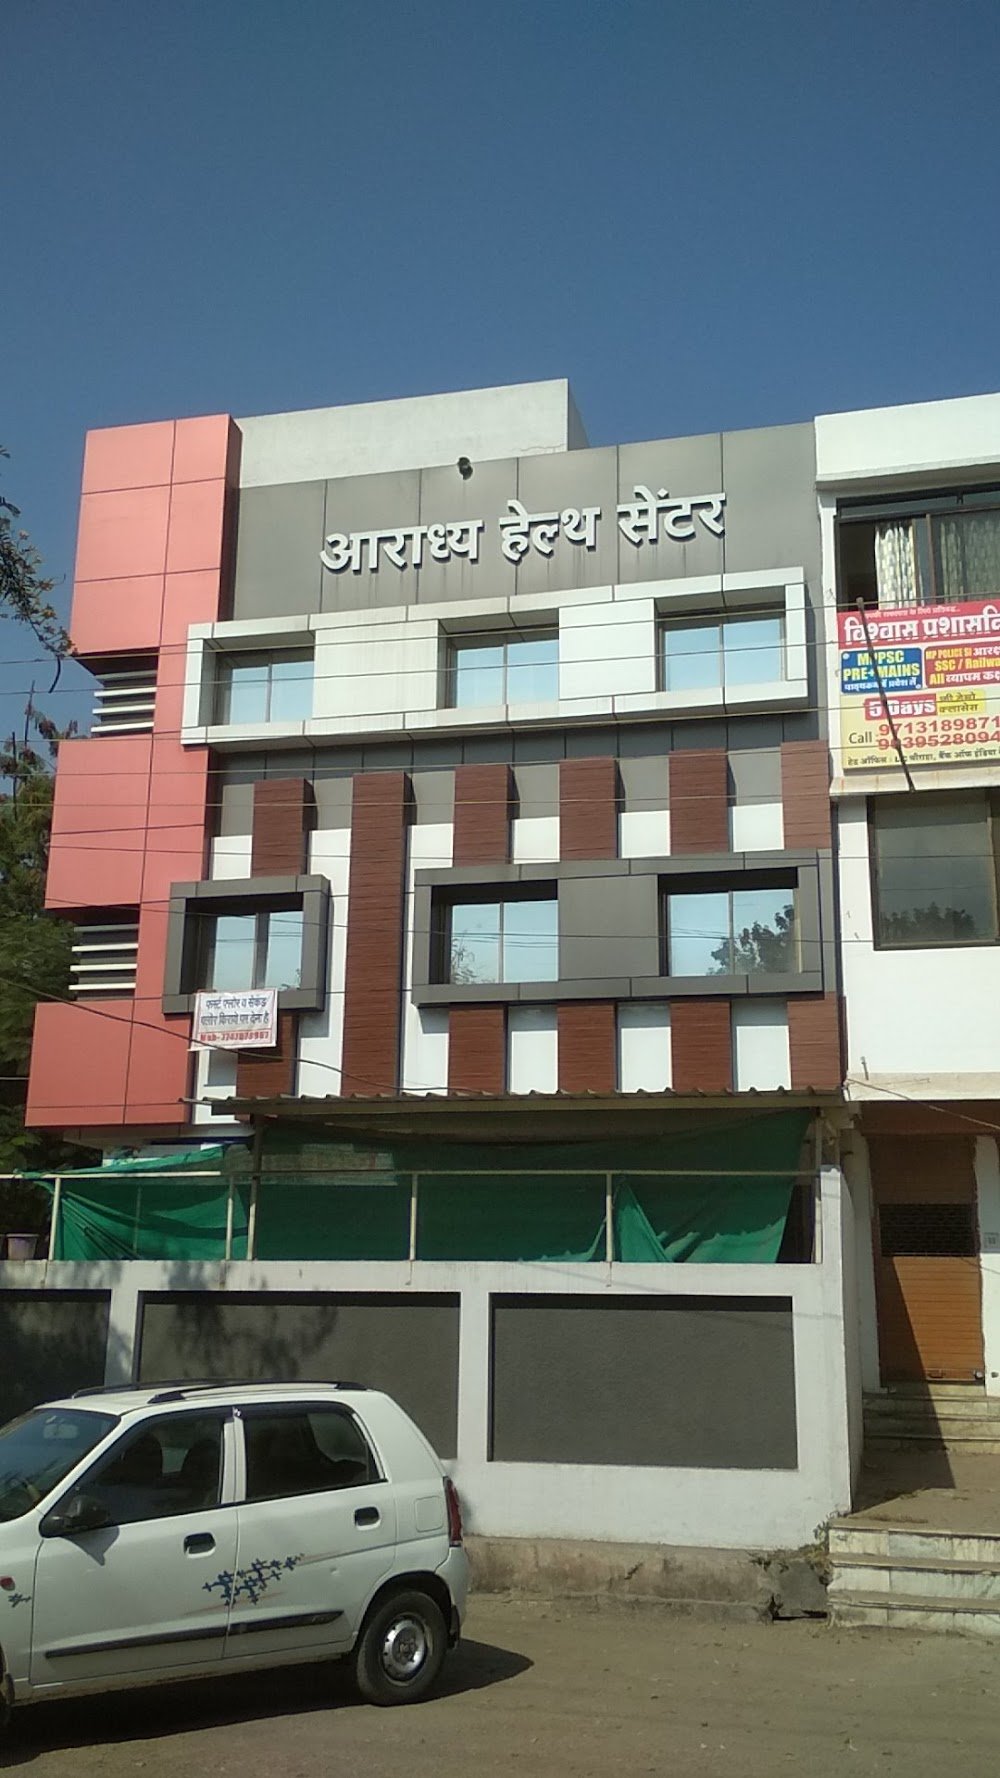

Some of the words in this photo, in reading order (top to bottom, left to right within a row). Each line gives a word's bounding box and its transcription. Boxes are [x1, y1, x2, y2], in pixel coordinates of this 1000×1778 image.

[320, 519, 484, 574] आराध्य
[499, 499, 602, 566] हेल्थ
[617, 484, 727, 545] सेंटर
[844, 616, 919, 645] विश्वास
[938, 648, 963, 659] POLICE
[935, 659, 956, 672] SSC
[929, 673, 945, 686] All
[945, 672, 981, 683] व्यापम
[869, 701, 882, 717] 5
[887, 699, 935, 716] Days
[879, 716, 1000, 736] 9713189871
[849, 731, 872, 744] Call
